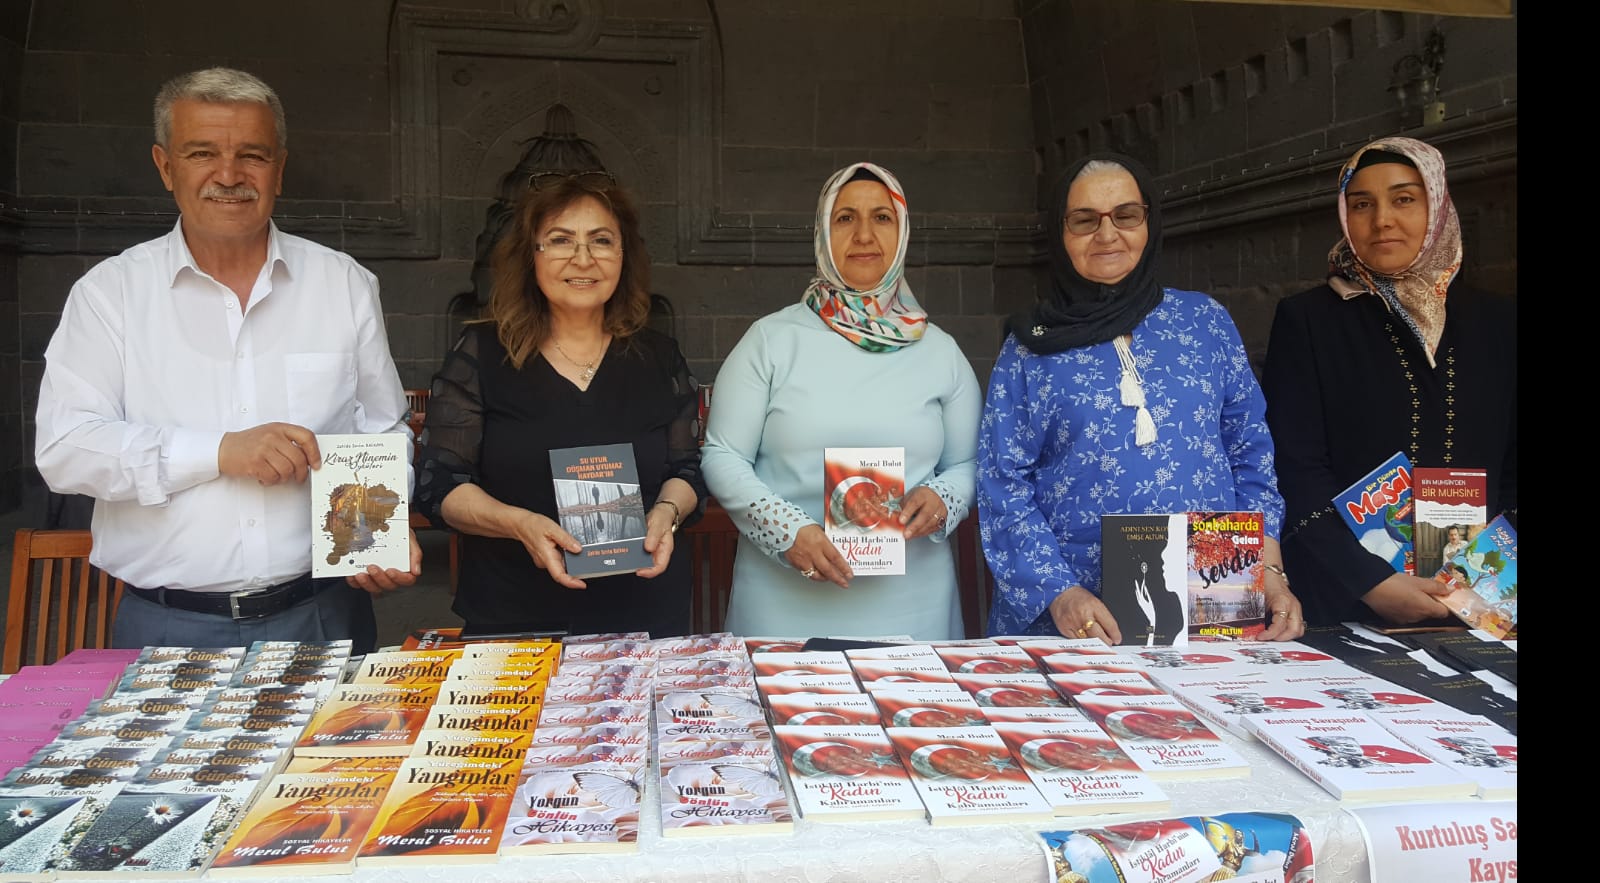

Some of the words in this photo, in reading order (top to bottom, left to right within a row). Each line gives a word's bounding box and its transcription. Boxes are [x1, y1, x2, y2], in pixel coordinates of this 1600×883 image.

[323, 452, 354, 468] Kiraz
[353, 451, 398, 463] Ninemin
[1422, 487, 1436, 497] BİR
[1438, 487, 1480, 497] MUHSİN'E
[1193, 518, 1259, 531] sonbaharda
[1231, 535, 1259, 545] Gelen
[841, 541, 883, 562] Kadın
[1199, 548, 1259, 589] sevda
[338, 691, 433, 705] Yangınlar
[448, 690, 540, 705] Yangınlar
[436, 713, 533, 731] Yangınlar
[424, 740, 527, 760] Yangınlar
[1148, 748, 1205, 760] Kadın
[1151, 757, 1226, 766] Kahramanları
[14, 772, 62, 785] Bahar
[62, 773, 118, 787] Güneşi
[148, 768, 193, 780] Bahar
[194, 770, 249, 785] Güneşi
[407, 767, 515, 788] Yangınlar
[46, 789, 71, 798] Ayşe
[180, 786, 205, 795] Ayşe
[274, 783, 386, 802] Yangınlar
[820, 785, 882, 801] Kadın
[1060, 780, 1122, 794] Kadın
[945, 789, 1008, 804] Kadın
[1064, 790, 1144, 799] Kahramanları
[820, 798, 901, 806] Kahramanları
[947, 801, 1029, 809] Kahramanları
[670, 806, 769, 820] Hikayesi
[378, 834, 433, 846] Meral
[438, 834, 490, 846] Bulut
[1395, 821, 1489, 851] Kurtuluş
[233, 846, 290, 857] Meral
[295, 844, 350, 855] Bulut
[1140, 846, 1186, 880] Kadın
[1149, 858, 1201, 883] ahramanları
